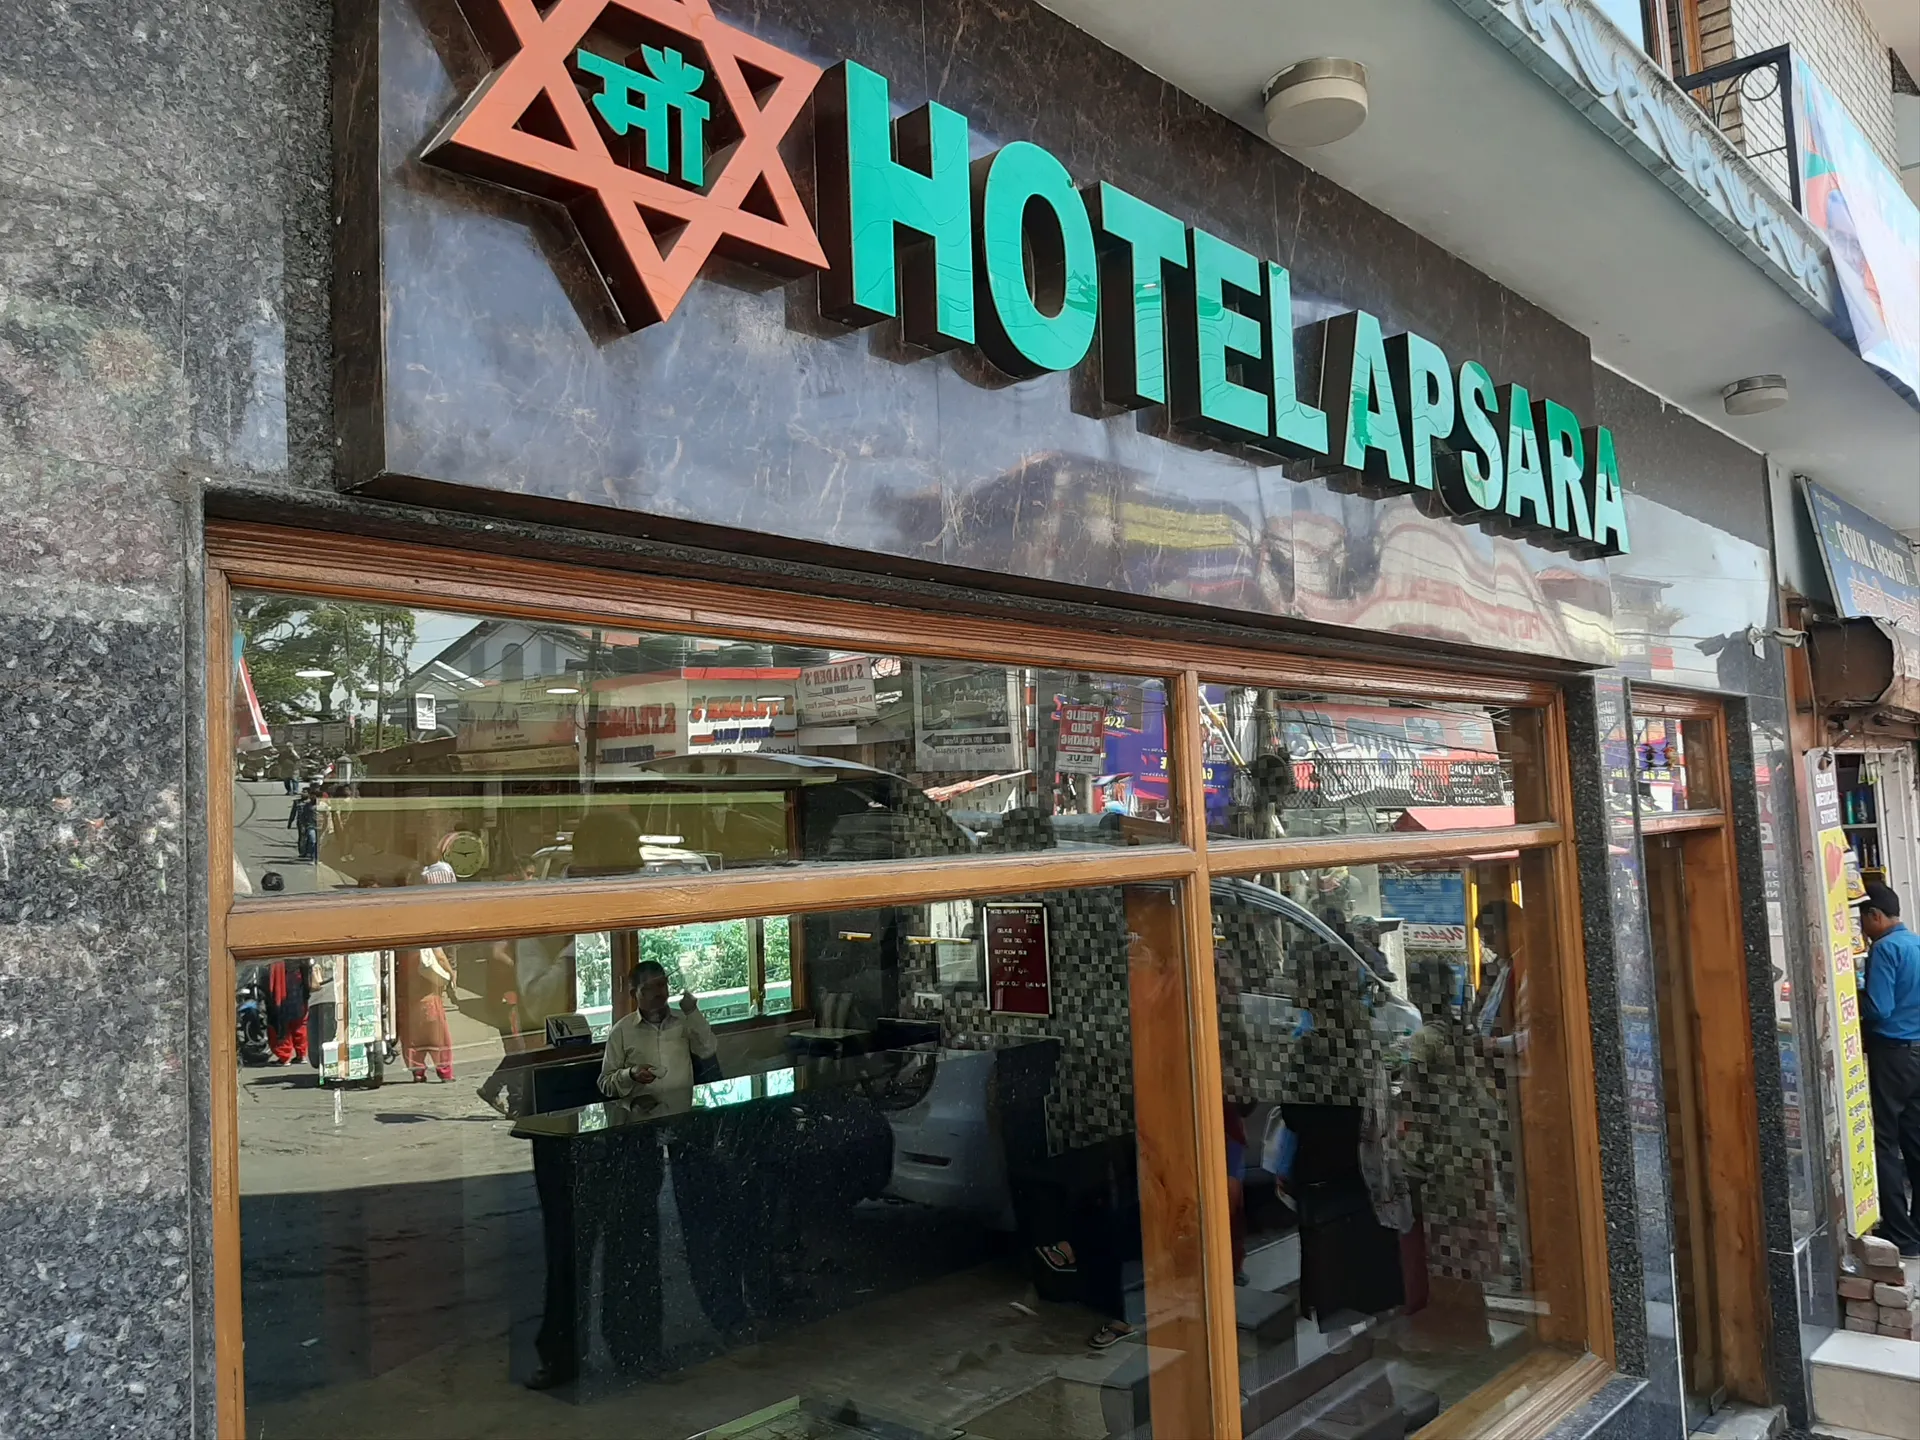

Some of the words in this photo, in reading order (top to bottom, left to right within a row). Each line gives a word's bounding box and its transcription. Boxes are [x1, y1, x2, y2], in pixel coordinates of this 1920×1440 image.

[845, 58, 1329, 455] HOTEL
[1343, 310, 1631, 556] APSARA
[1835, 520, 1875, 570] GOKUL
[1870, 538, 1909, 586] CHEMIST
